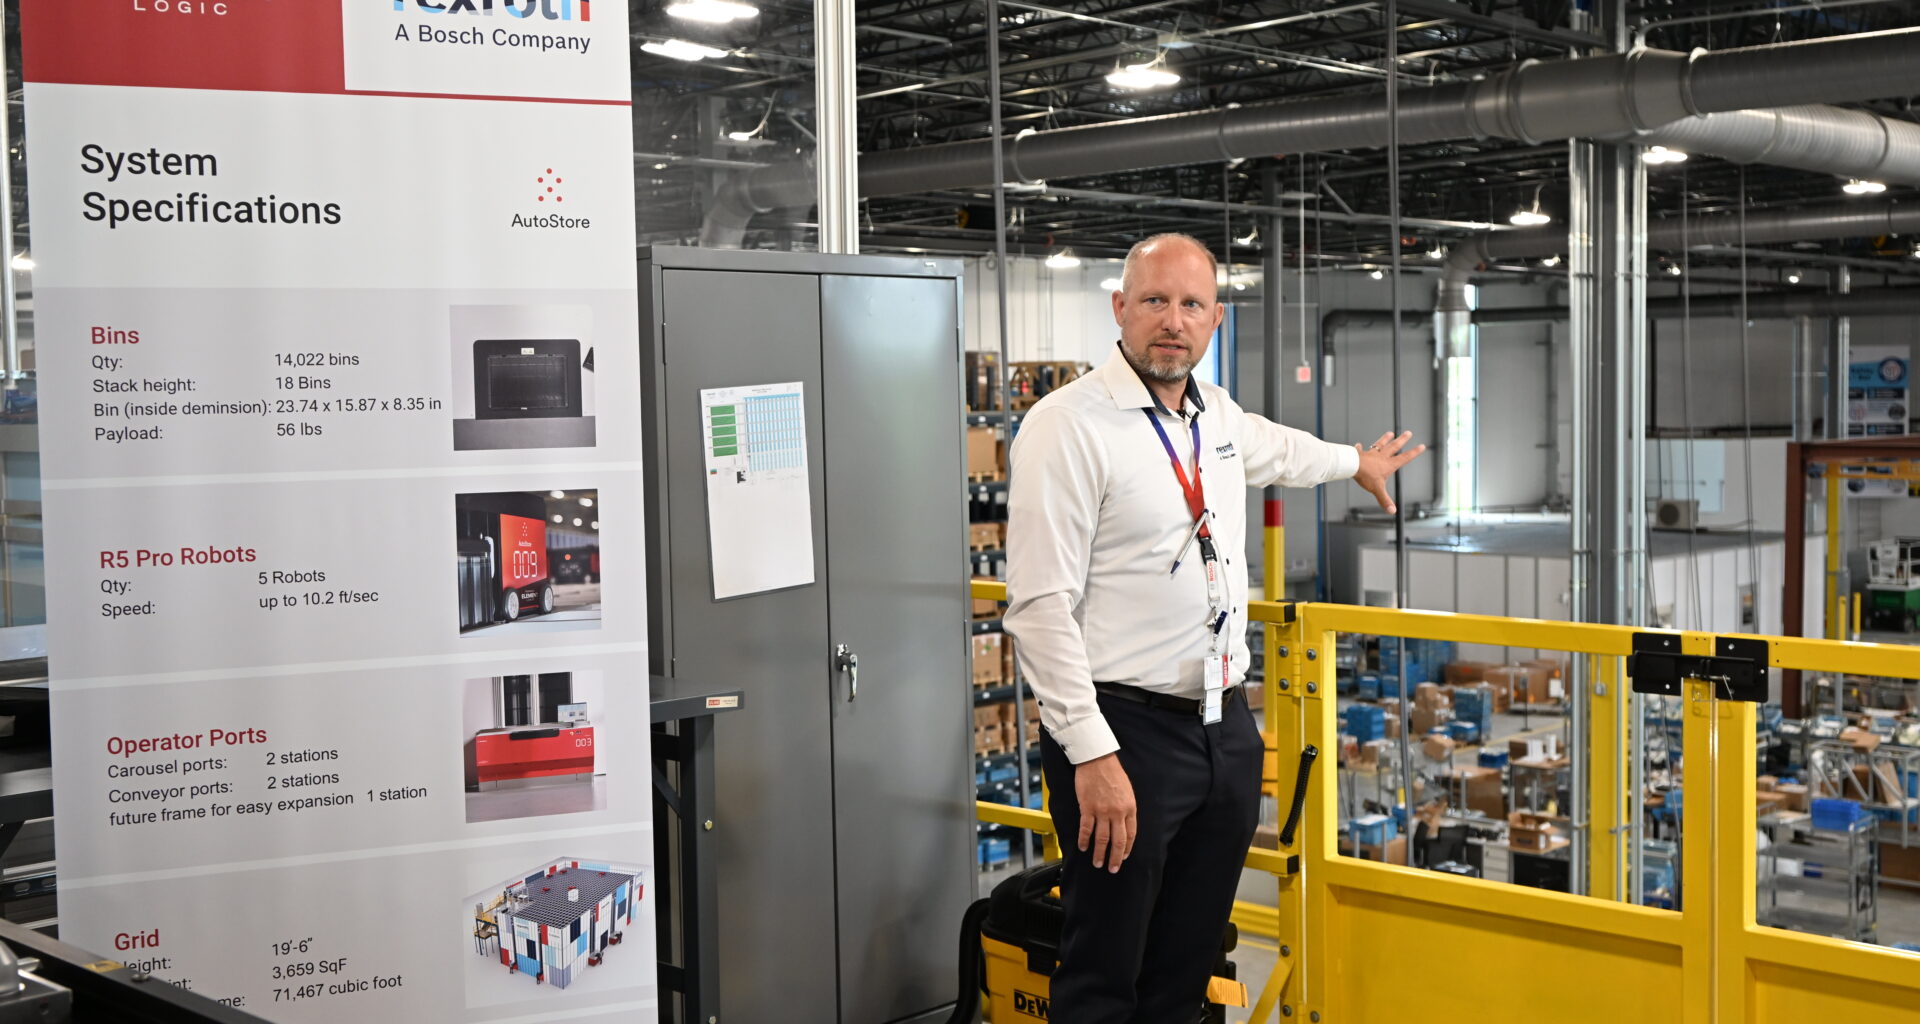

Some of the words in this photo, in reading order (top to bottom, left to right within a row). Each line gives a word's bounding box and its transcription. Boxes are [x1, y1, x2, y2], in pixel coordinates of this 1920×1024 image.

[133, 0, 227, 15] LOGIC
[394, 23, 411, 42] A
[418, 23, 484, 46] Bosch
[491, 28, 591, 55] Company
[80, 143, 218, 183] System
[82, 191, 342, 230] Specifications
[510, 213, 591, 229] AutoStore
[90, 325, 140, 345] Bins
[91, 354, 123, 373] Qty:
[274, 352, 325, 369] 14,022
[328, 352, 360, 366] bins
[92, 378, 139, 393] Stack
[143, 377, 196, 396] height:
[275, 376, 295, 390] 18
[298, 375, 332, 390] Bins
[93, 402, 120, 417] Bin
[124, 401, 178, 420] (inside
[181, 399, 272, 417] deminsion):
[275, 399, 319, 414] 23.74
[322, 401, 331, 413] x
[335, 397, 377, 413] 15.87
[380, 400, 390, 412] x
[393, 397, 425, 411] 8.35
[428, 396, 442, 411] in
[94, 425, 164, 444] Payload:
[276, 422, 296, 437] 56
[300, 421, 323, 437] lbs
[99, 549, 130, 570] R5
[136, 549, 174, 568] Pro
[180, 544, 257, 566] Robots
[513, 550, 538, 579] 009
[100, 579, 132, 596] Qty:
[258, 571, 268, 586] 5
[272, 569, 326, 585] Robots
[101, 600, 156, 620] Speed:
[259, 597, 279, 612] up
[282, 594, 298, 607] to
[302, 590, 335, 606] 10.2
[338, 589, 379, 604] ft/sec
[106, 731, 204, 758] Operator
[209, 727, 268, 747] Ports
[575, 738, 592, 747] 003
[266, 751, 276, 766] 2
[280, 748, 339, 765] stations
[107, 759, 178, 779] Carousel
[182, 757, 228, 776] ports:
[266, 775, 277, 790] 2
[281, 772, 340, 789] stations
[108, 785, 186, 804] Conveyor
[188, 780, 233, 800] ports:
[367, 788, 374, 803] 1
[379, 785, 428, 802] station
[108, 811, 157, 827] future
[160, 807, 207, 822] frame
[210, 802, 233, 817] for
[236, 801, 273, 816] easy
[277, 792, 354, 813] expansion
[114, 927, 160, 951] Grid
[123, 957, 171, 975] eight:
[272, 961, 315, 981] 3,659
[318, 957, 348, 976] SqF
[272, 983, 325, 1003] 71,467
[328, 978, 369, 995] cubic
[372, 974, 403, 990] foot
[1014, 991, 1050, 1018] DEW
